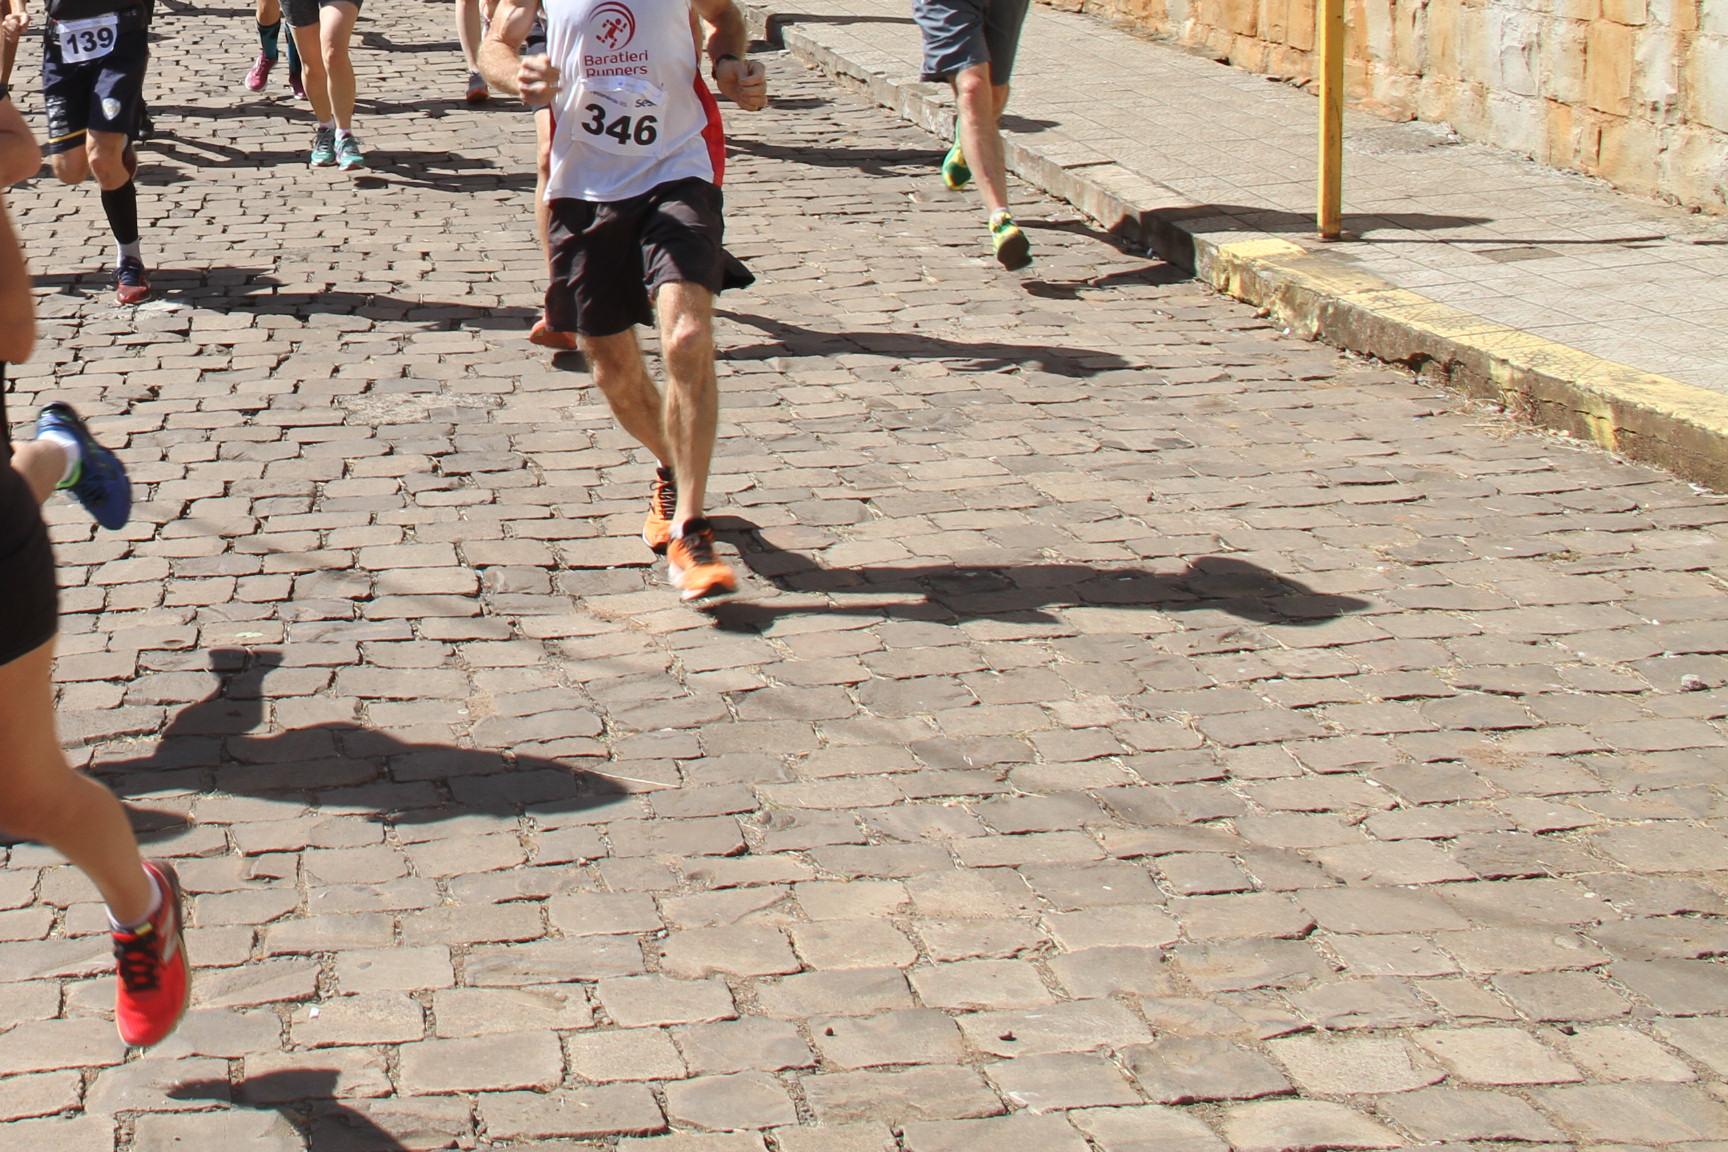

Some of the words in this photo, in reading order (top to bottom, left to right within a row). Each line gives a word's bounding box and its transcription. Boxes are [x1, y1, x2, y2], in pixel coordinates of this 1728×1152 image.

[66, 26, 114, 55] 139
[584, 50, 649, 66] Baratieri
[585, 65, 648, 78] Runners
[581, 103, 658, 146] 346
